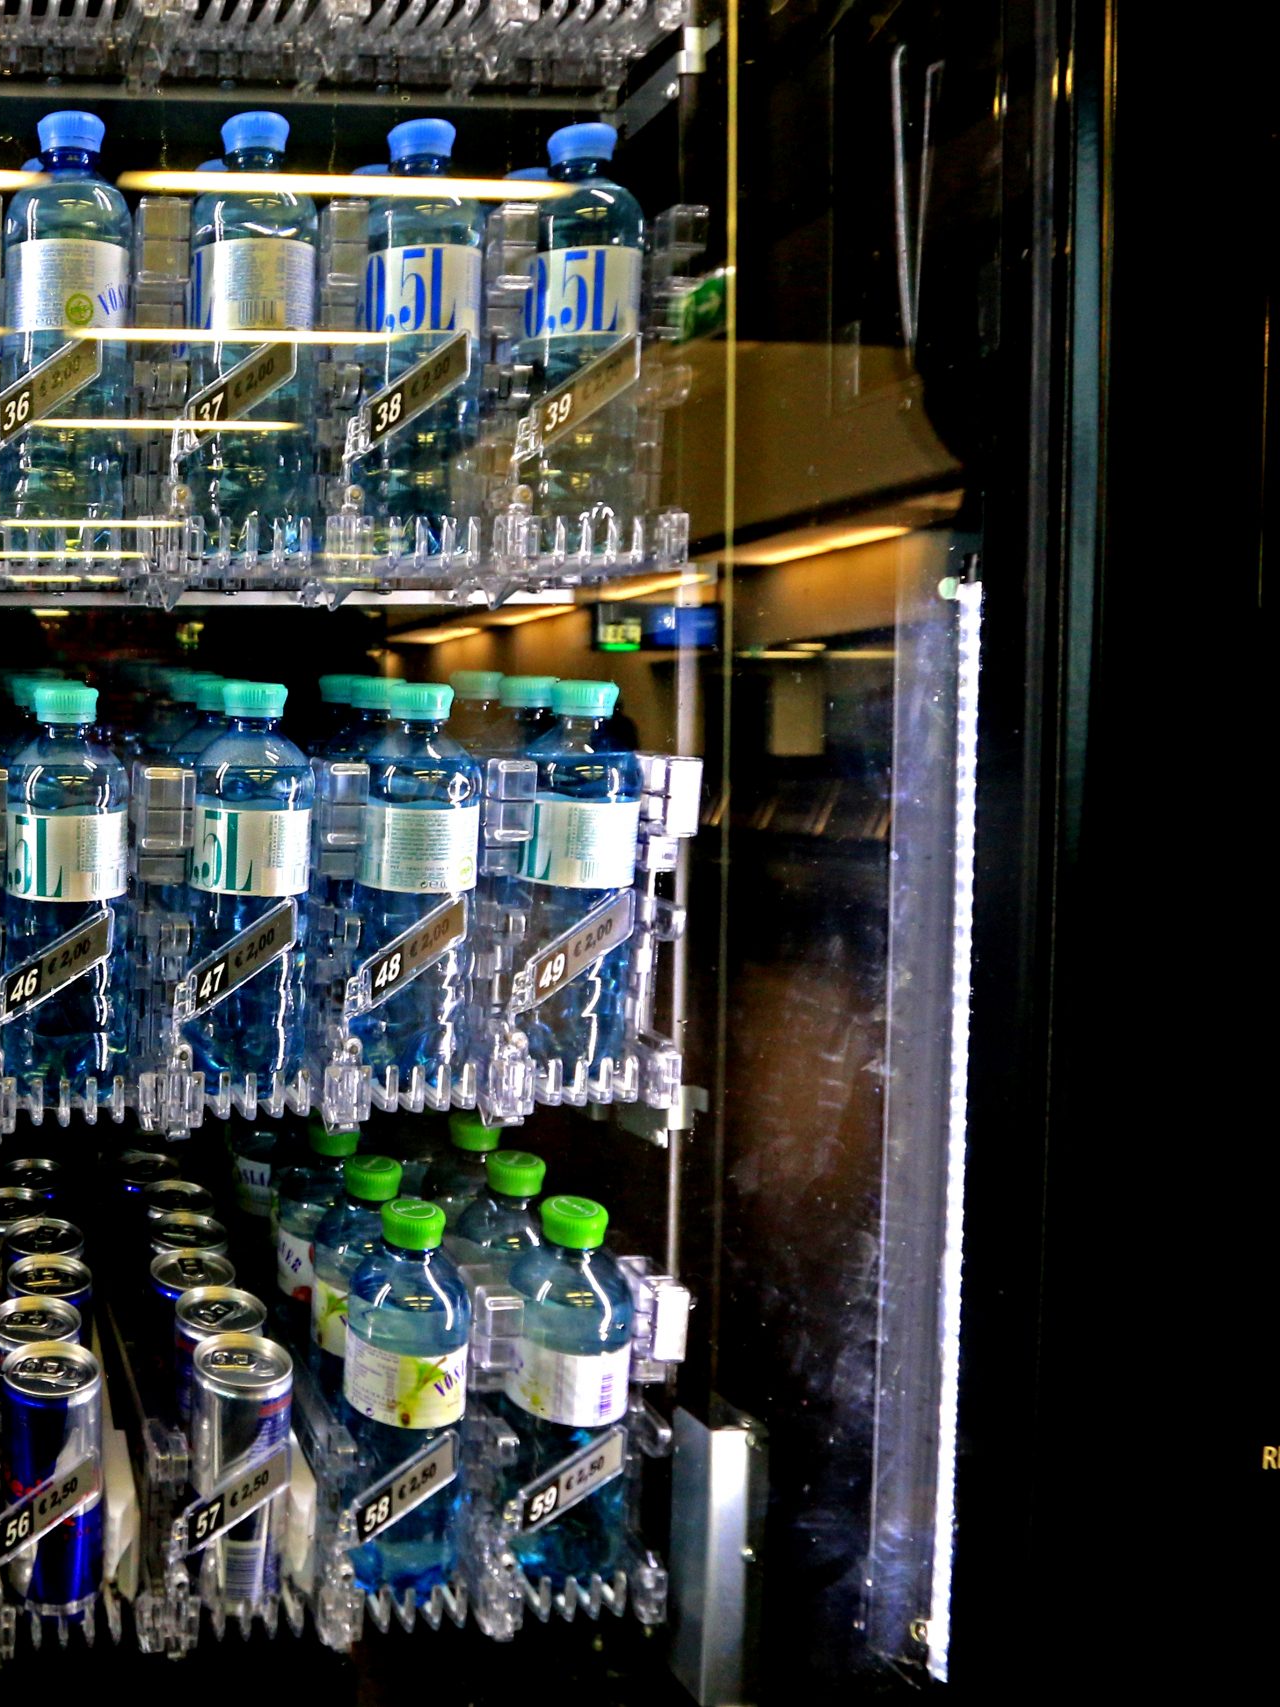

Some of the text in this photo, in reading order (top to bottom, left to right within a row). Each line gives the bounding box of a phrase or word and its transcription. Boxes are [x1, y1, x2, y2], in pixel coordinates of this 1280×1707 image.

[3, 357, 82, 430] 36 € 2,00
[198, 358, 275, 422] 37 € 2,00
[376, 393, 402, 432] 38
[546, 393, 572, 430] 39
[10, 939, 91, 1001] 46 € 2,00
[199, 929, 275, 998] 47 € 2,00
[375, 918, 451, 988] 48 € 2,00
[539, 918, 613, 988] 49 € 2,00
[5, 1477, 78, 1547] 56 € 2,50
[195, 1471, 270, 1538] 57 € 2,50
[363, 1462, 437, 1531] 58 € 2,50
[530, 1454, 606, 1525] 59 € 2,50
